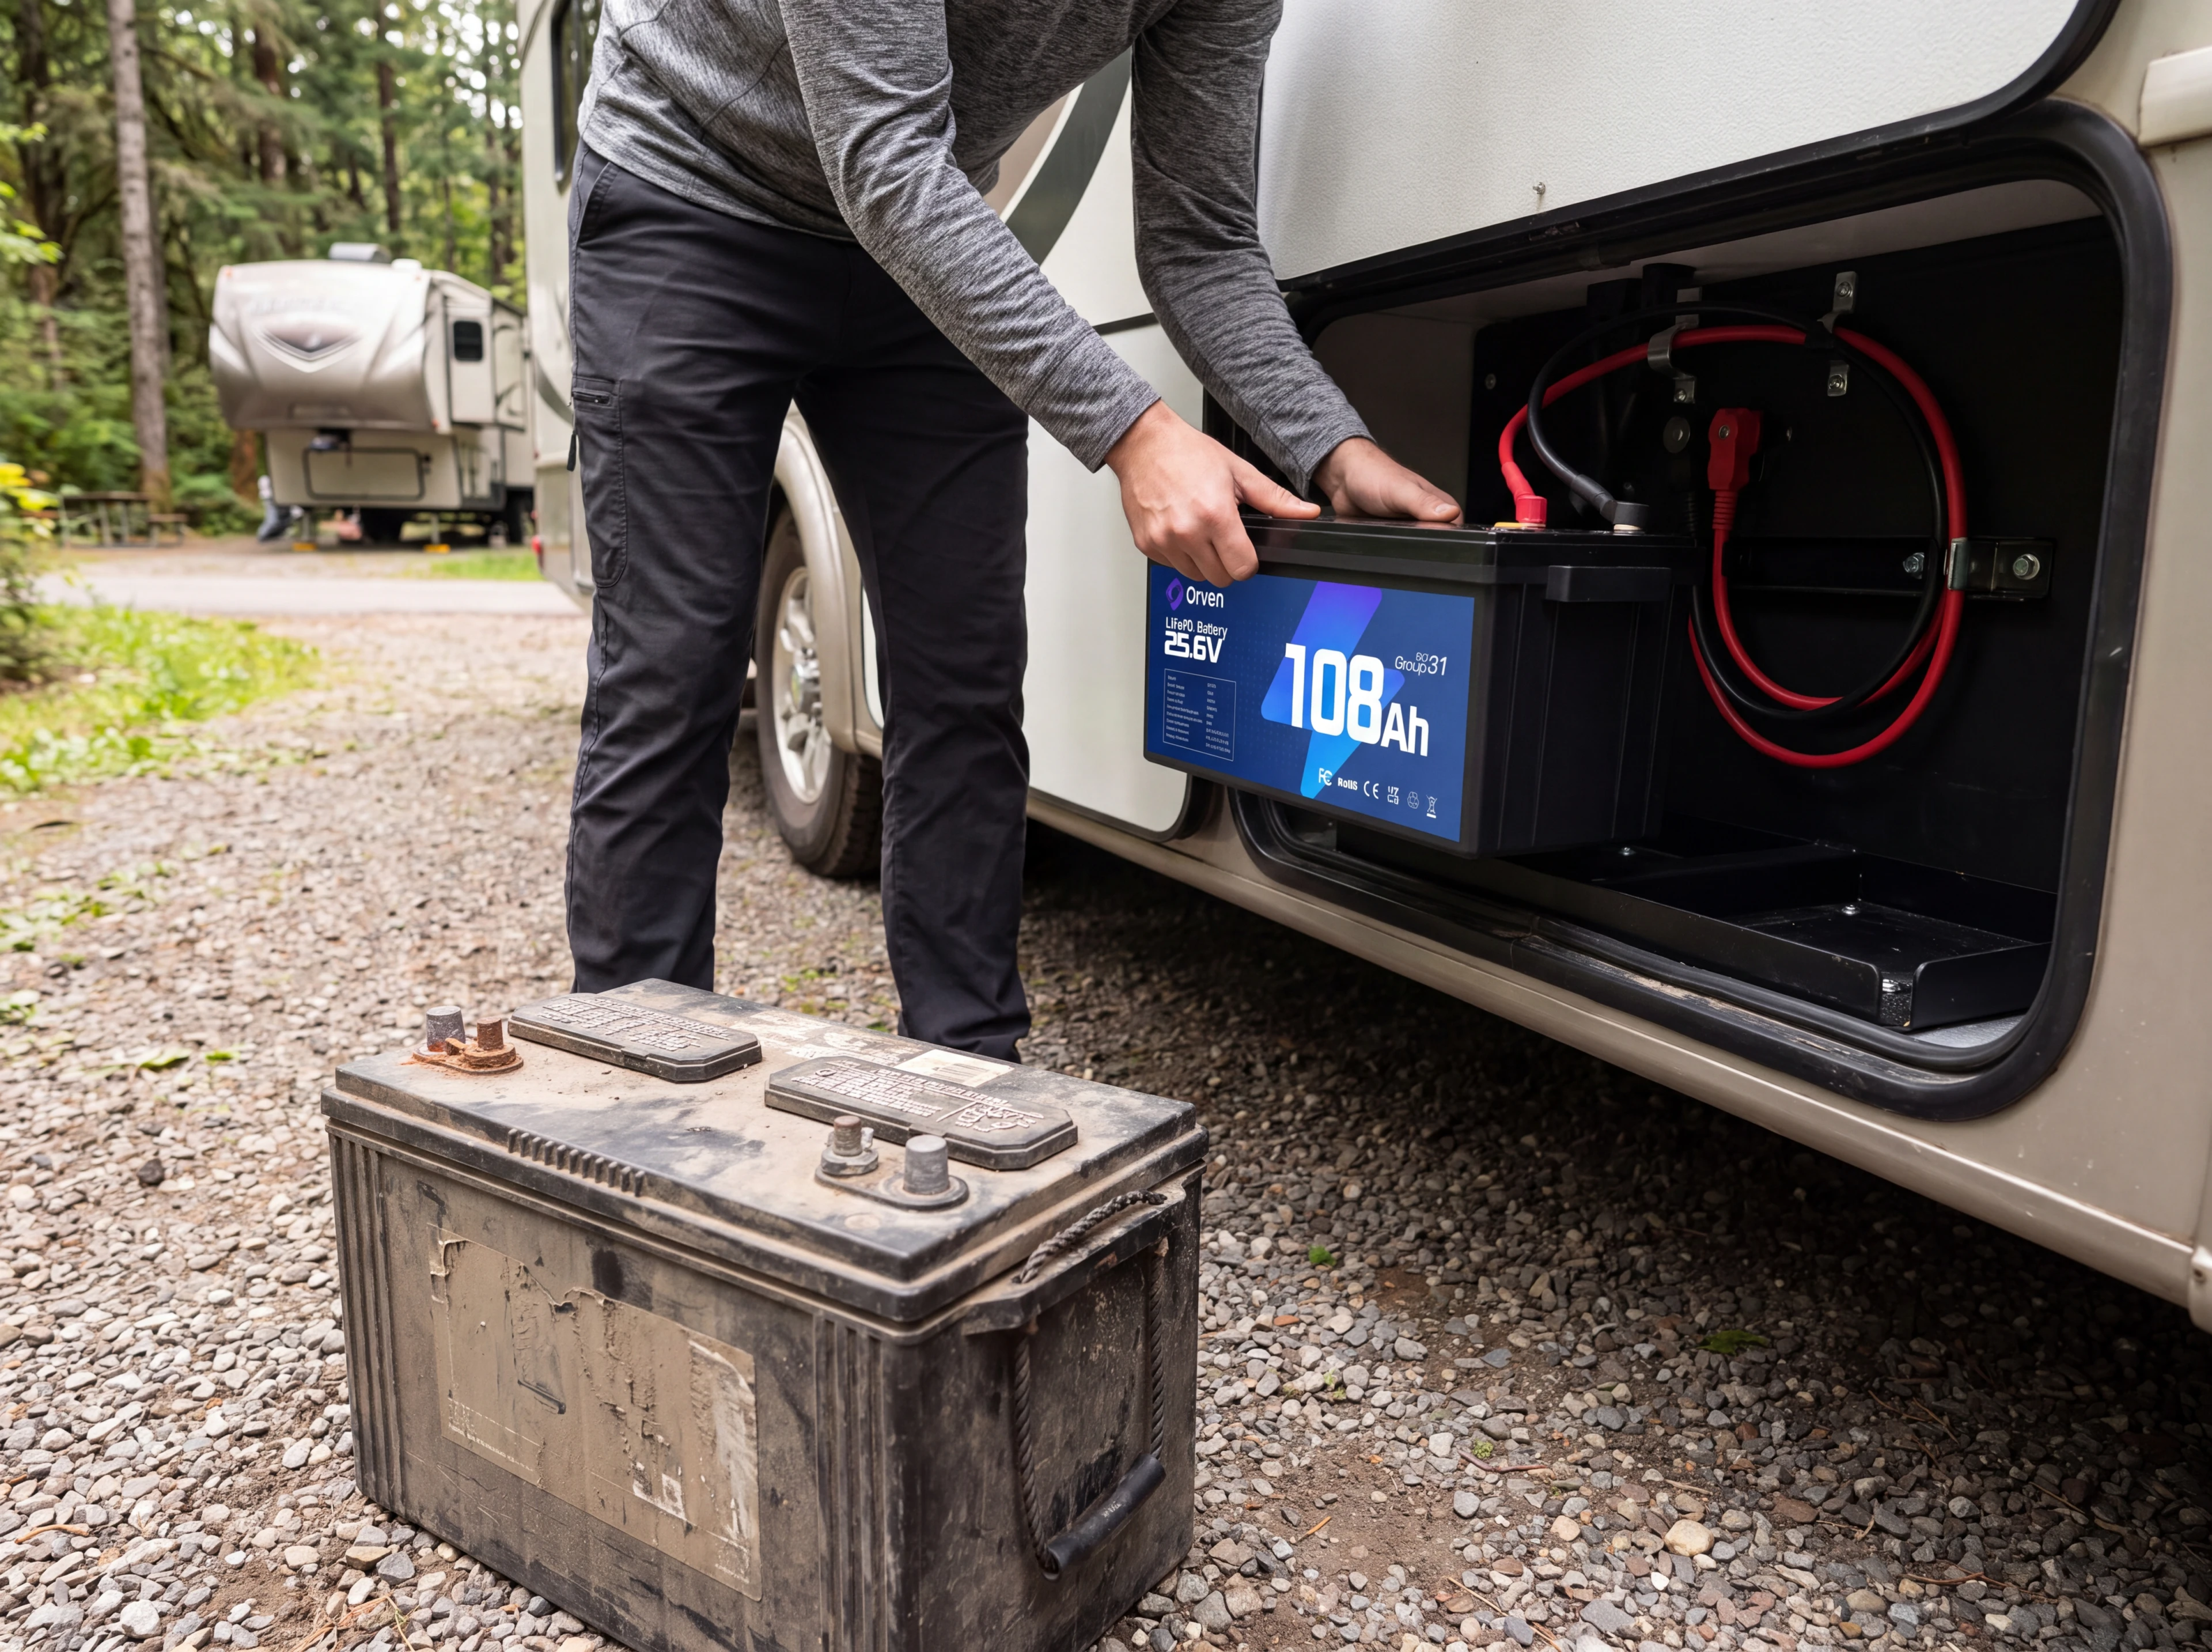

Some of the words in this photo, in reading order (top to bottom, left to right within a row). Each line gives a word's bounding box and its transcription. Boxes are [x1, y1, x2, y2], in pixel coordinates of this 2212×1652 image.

[1186, 586, 1224, 608] Orven
[1164, 630, 1223, 664] 25.6V
[1363, 780, 1379, 800] CE
